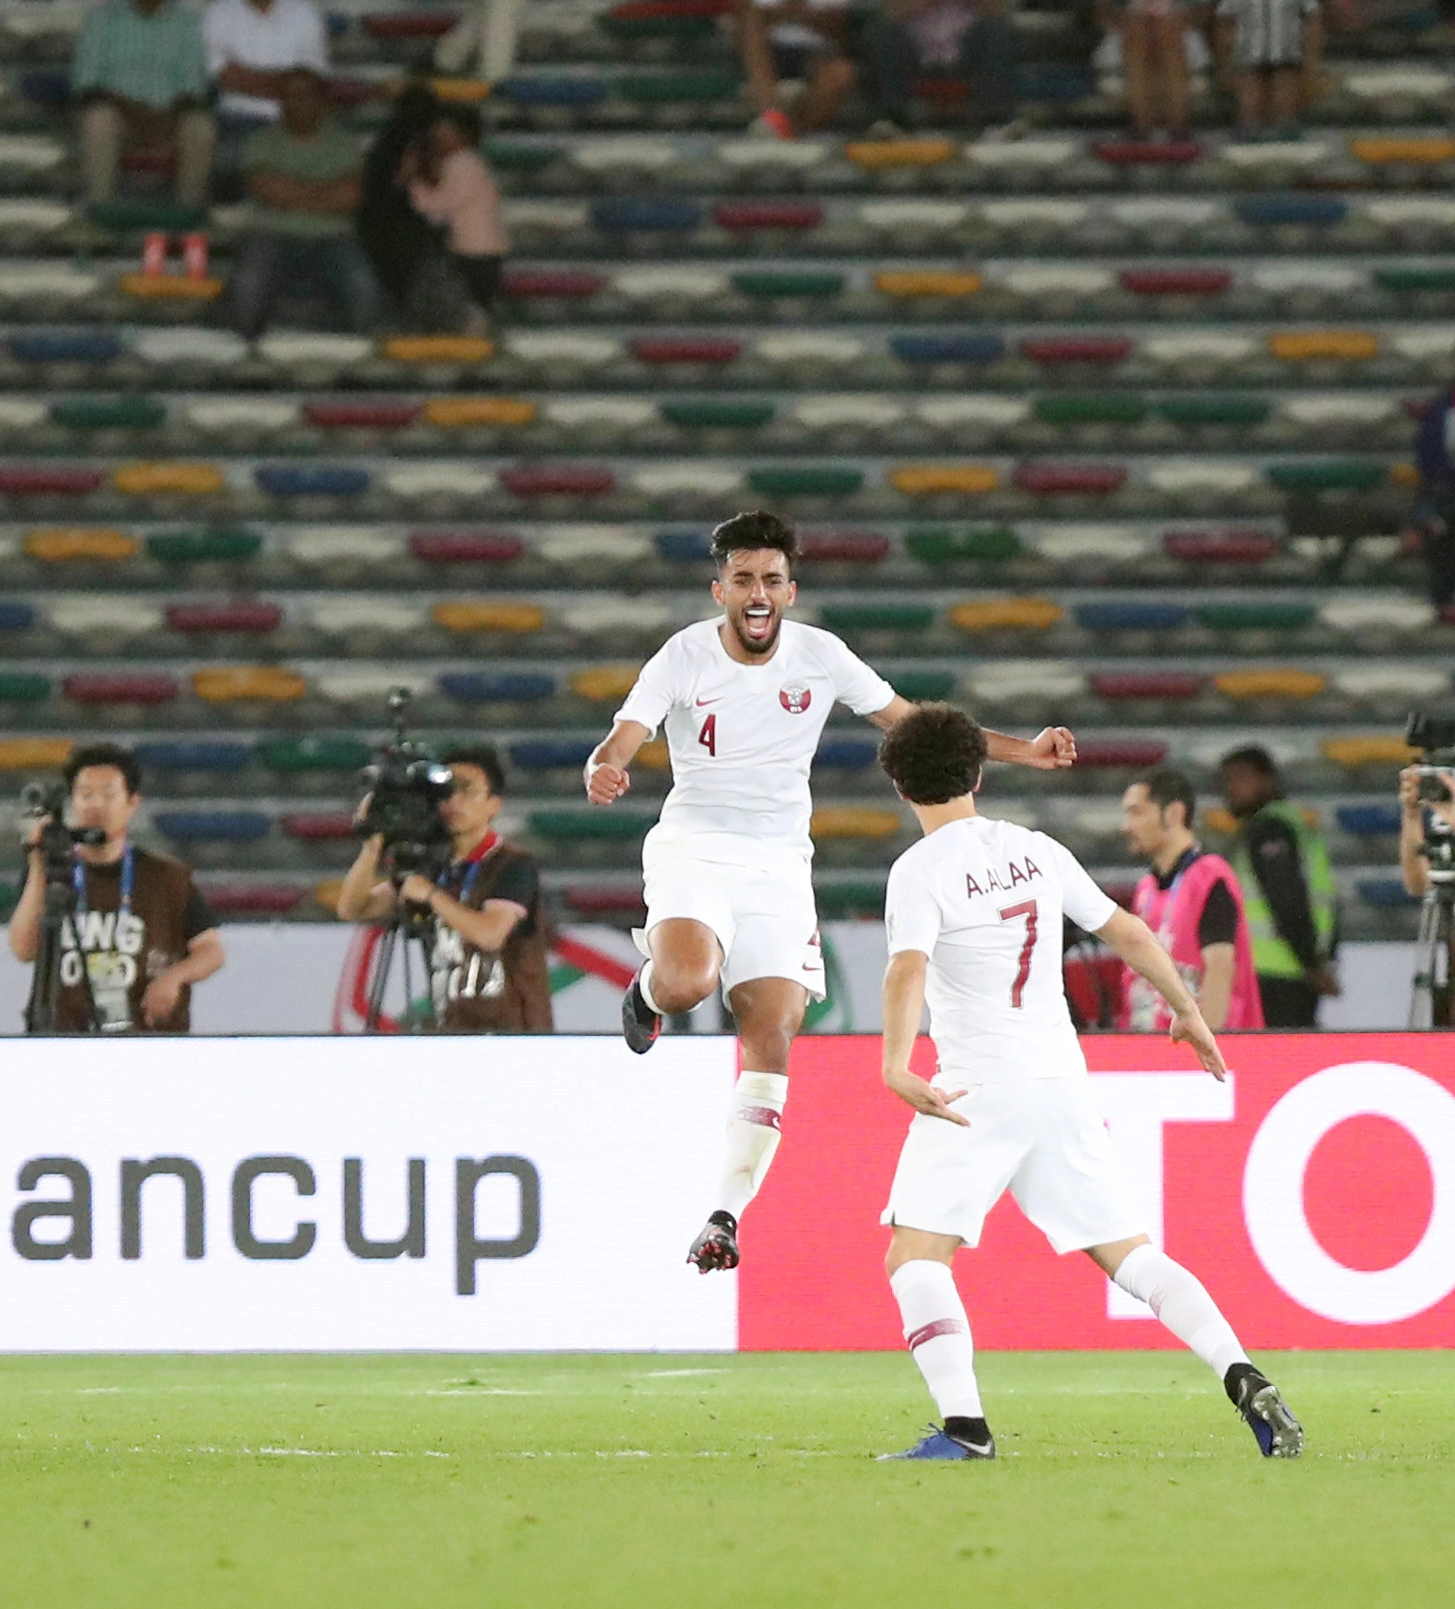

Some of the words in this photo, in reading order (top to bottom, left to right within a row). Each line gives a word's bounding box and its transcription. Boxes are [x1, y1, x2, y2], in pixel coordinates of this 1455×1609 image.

[698, 713, 716, 757] 4
[965, 856, 1043, 899] A.ALAA
[996, 898, 1038, 1009] 7
